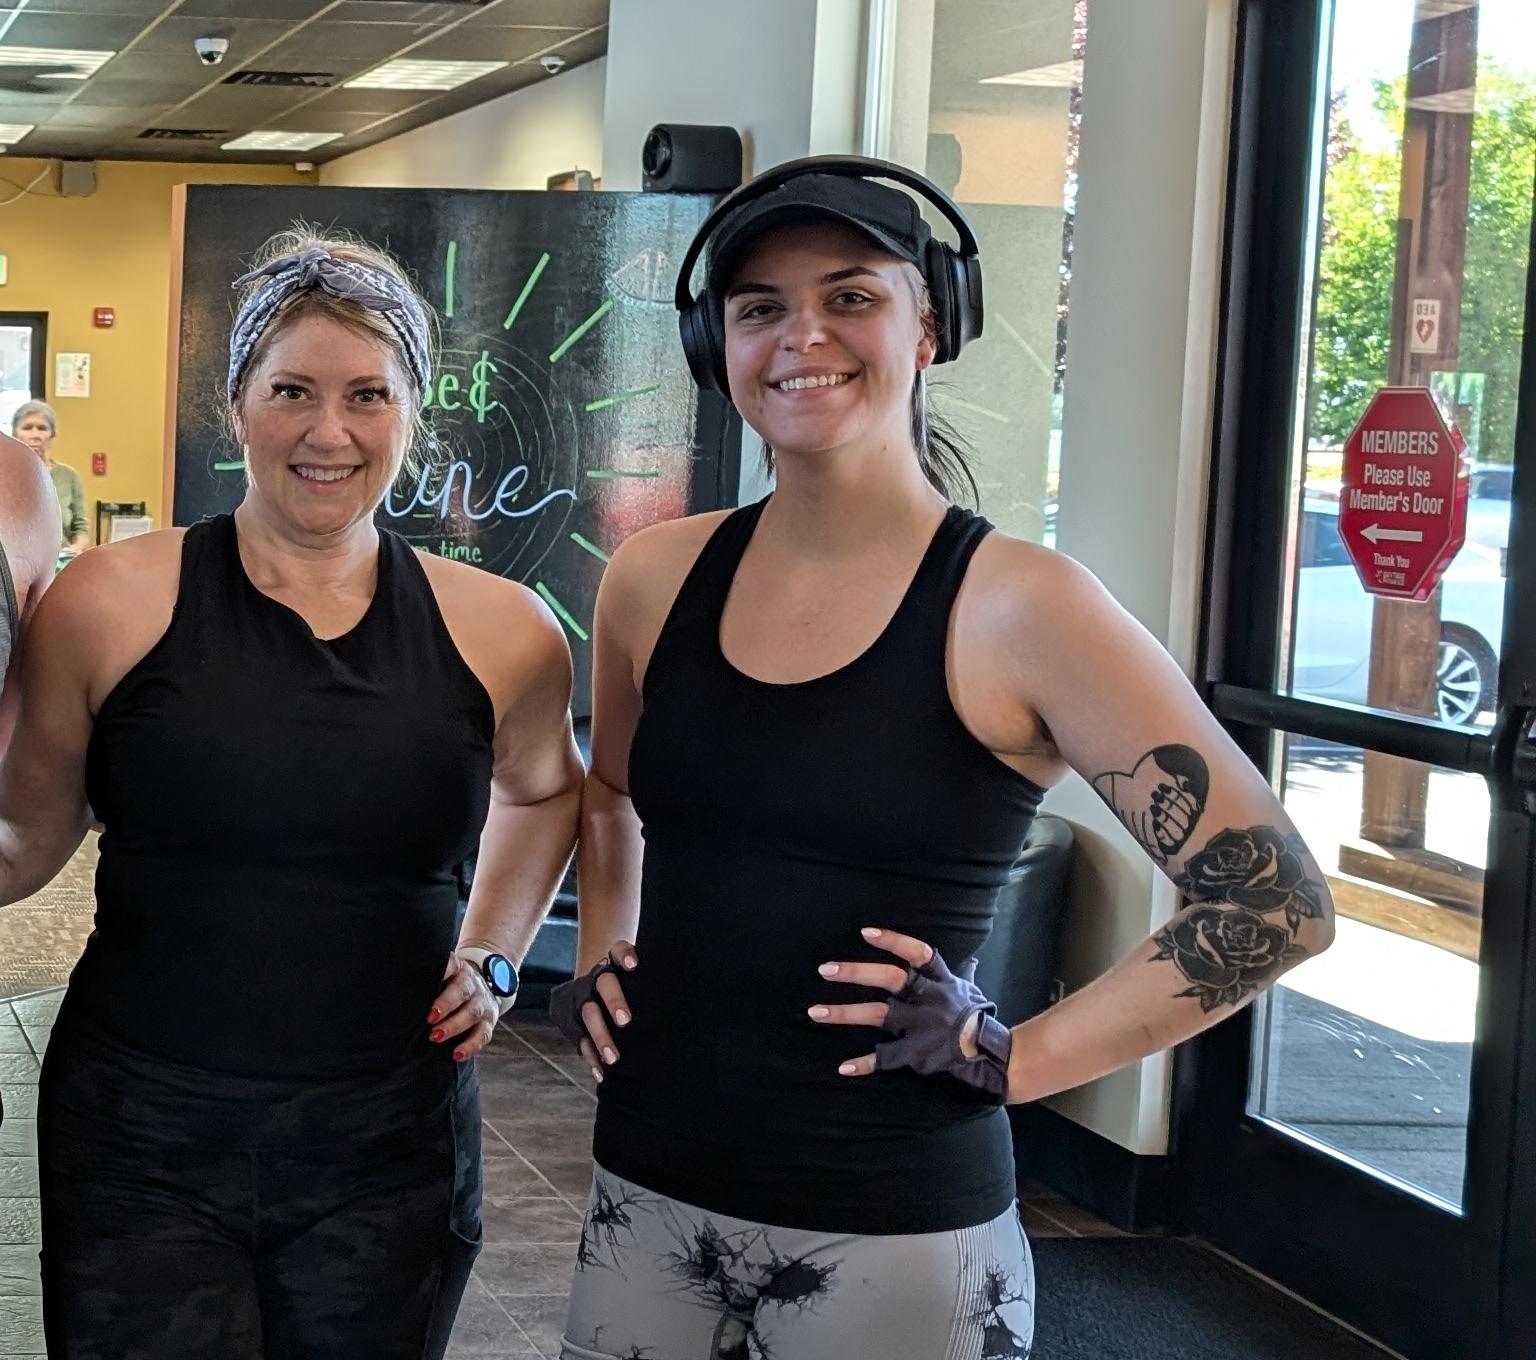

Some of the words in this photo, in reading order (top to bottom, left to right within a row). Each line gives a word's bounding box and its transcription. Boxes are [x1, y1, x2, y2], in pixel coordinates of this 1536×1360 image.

[1361, 430, 1439, 456] MEMBERS
[1364, 463, 1404, 487] Please
[1407, 465, 1431, 488] Use
[1349, 488, 1410, 514] Member's
[1412, 492, 1444, 516] Door
[439, 540, 483, 563] time
[1373, 552, 1396, 567] Thank
[1396, 555, 1410, 569] You
